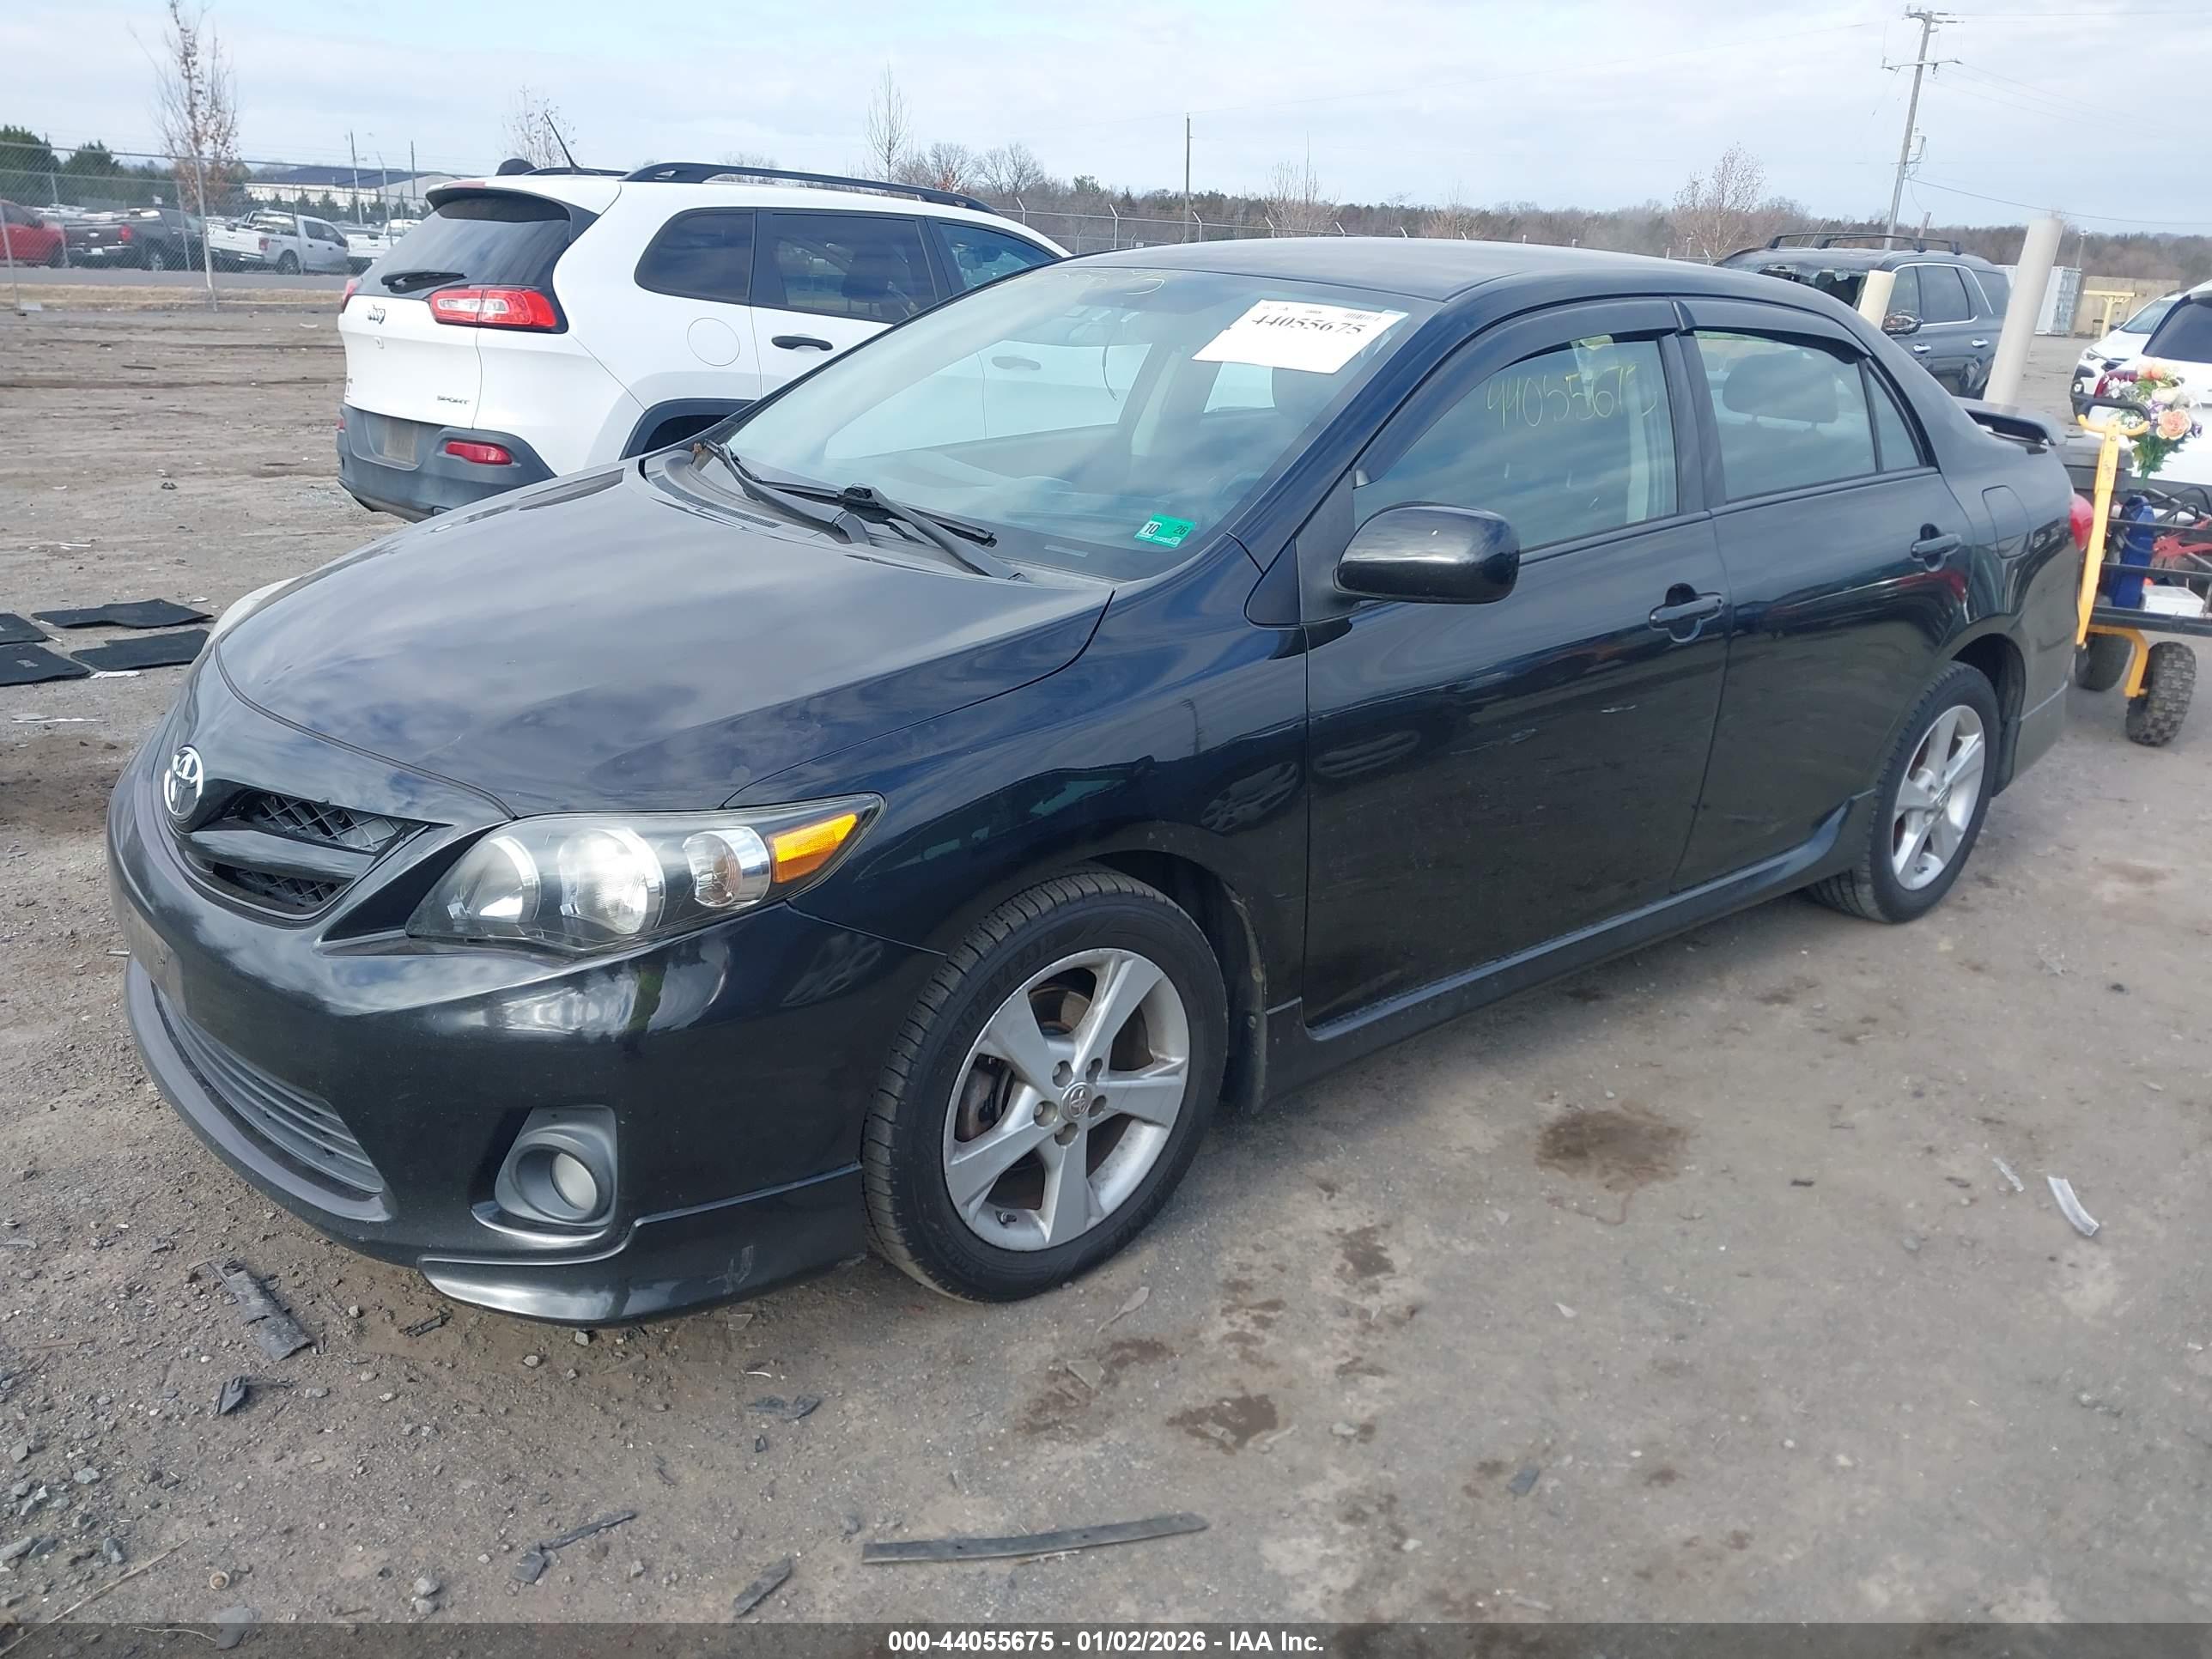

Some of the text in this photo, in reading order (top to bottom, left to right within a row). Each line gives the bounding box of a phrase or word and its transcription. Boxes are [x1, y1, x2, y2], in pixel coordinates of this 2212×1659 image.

[1251, 314, 1368, 334] 44055675
[1144, 523, 1189, 535] 10 26
